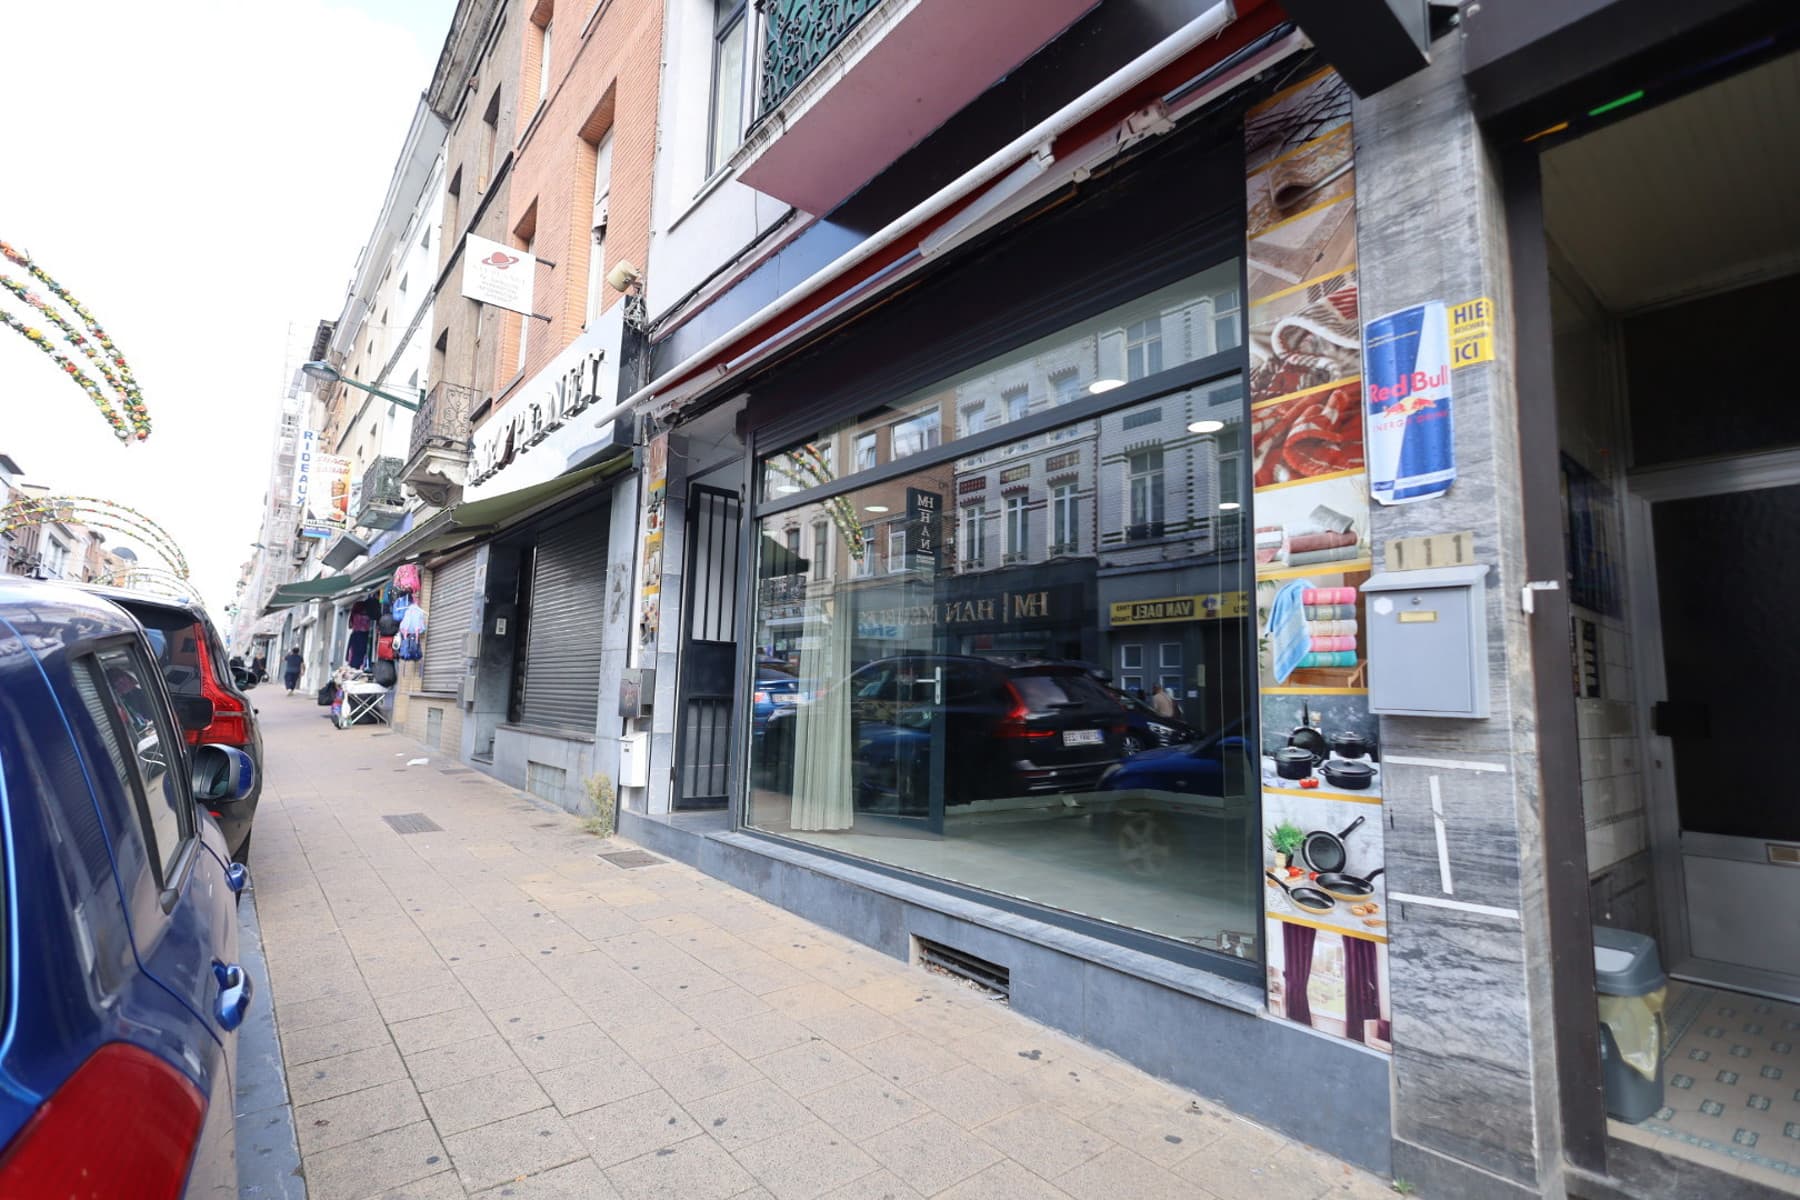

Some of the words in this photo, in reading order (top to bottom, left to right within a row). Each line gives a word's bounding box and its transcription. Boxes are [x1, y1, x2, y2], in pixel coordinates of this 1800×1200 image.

[1455, 342, 1479, 363] ICI
[1369, 374, 1408, 403] Red
[1410, 364, 1449, 392] Bull
[297, 431, 313, 504] RIDEAUX
[1394, 534, 1462, 569] 111
